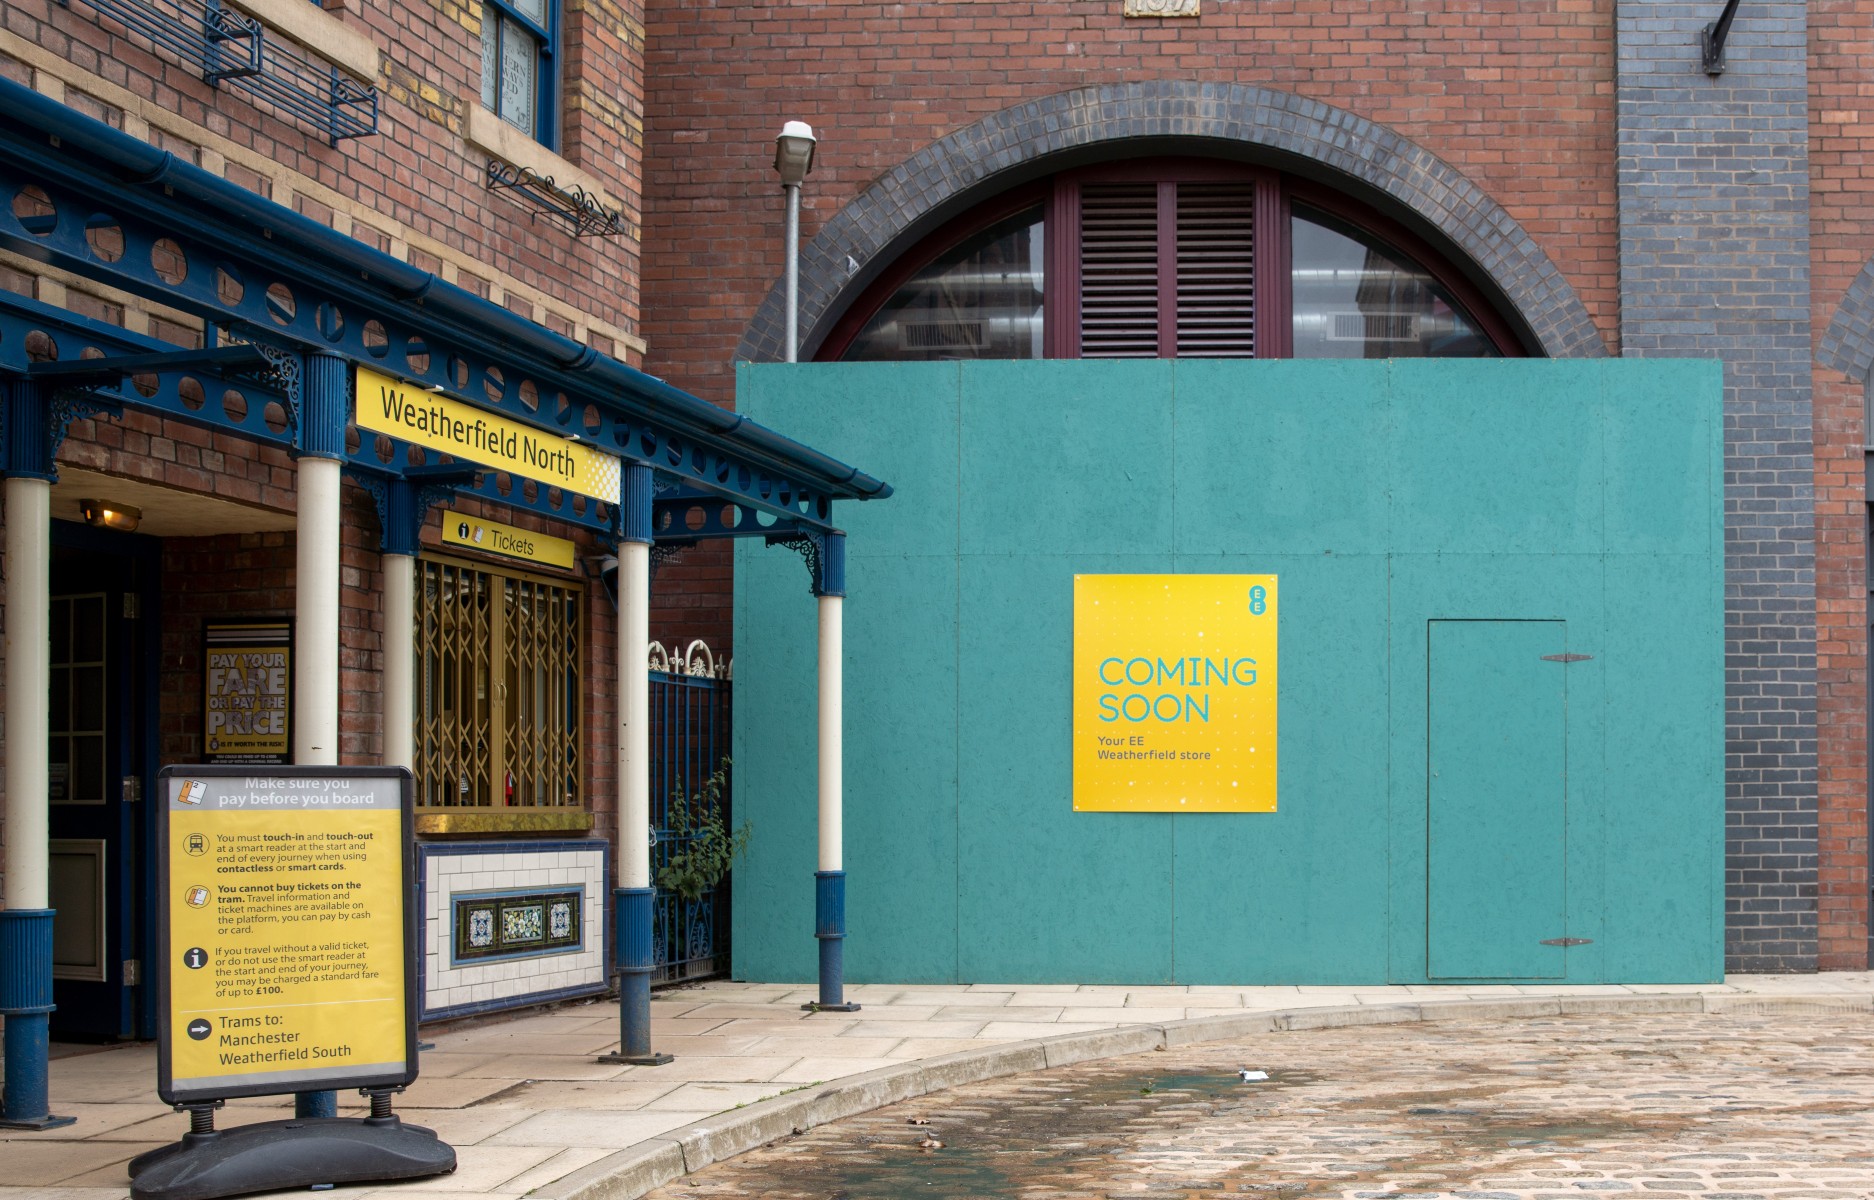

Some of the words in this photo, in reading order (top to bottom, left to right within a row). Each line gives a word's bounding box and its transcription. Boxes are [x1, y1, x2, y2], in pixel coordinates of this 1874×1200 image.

[381, 386, 518, 460] Weatherfield
[523, 436, 575, 478] North
[492, 530, 534, 555] Tickets
[211, 654, 239, 668] PAY
[243, 654, 285, 667] YOUR
[1099, 657, 1257, 686] COMING
[209, 668, 285, 695] FARE
[209, 697, 228, 709] OR
[232, 697, 257, 709] PAY
[259, 697, 285, 709] THE
[1099, 693, 1209, 723] SOON
[208, 711, 284, 735] PRICE
[1097, 737, 1125, 746] Your
[1129, 737, 1144, 746] EE
[1097, 750, 1176, 760] Weatherfield
[1180, 751, 1211, 760] store
[244, 779, 285, 791] Make
[288, 780, 320, 790] sure
[322, 781, 350, 791] you
[219, 796, 246, 807] pay
[251, 792, 298, 804] before
[302, 796, 328, 807] you
[333, 792, 374, 804] board
[217, 834, 234, 842] You
[263, 833, 304, 841] touch-in
[326, 832, 373, 840] touch-out
[266, 843, 295, 851] reader
[349, 842, 365, 850] and
[217, 855, 235, 863] end
[238, 854, 248, 862] of
[277, 854, 313, 863] journey
[343, 853, 366, 861] using
[217, 864, 273, 873] contactless
[319, 862, 346, 870] cards.
[218, 885, 236, 893] You
[277, 883, 295, 893] buy
[346, 881, 361, 889] the
[247, 894, 274, 902] Travel
[277, 891, 327, 901] information
[333, 891, 350, 899] and
[218, 905, 244, 914] ticket
[247, 904, 291, 912] machines
[311, 902, 350, 910] available
[218, 916, 234, 924] the
[237, 914, 279, 925] platform,
[282, 915, 299, 923] you
[320, 914, 336, 922] pay
[339, 912, 349, 921] by
[351, 911, 370, 919] cash
[231, 925, 253, 934] card.
[216, 947, 222, 955] If
[224, 949, 241, 957] you
[244, 945, 270, 954] travel
[273, 944, 309, 953] without
[319, 942, 340, 950] valid
[343, 941, 369, 949] ticket,
[228, 957, 239, 965] do
[281, 955, 296, 963] the
[298, 954, 324, 962] smart
[327, 952, 355, 960] reader
[216, 968, 231, 976] the
[258, 965, 275, 974] and
[278, 965, 296, 973] end
[299, 964, 308, 972] of
[310, 965, 330, 973] your
[332, 963, 369, 971] journey,
[216, 980, 233, 988] you
[237, 979, 256, 987] may
[273, 974, 310, 984] charged
[321, 971, 359, 981] standard
[216, 989, 226, 997] of
[228, 990, 241, 998] up
[256, 986, 283, 995] £100.
[219, 1016, 261, 1028] Trams
[265, 1015, 282, 1025] to:
[220, 1032, 300, 1047] Manchester
[219, 1048, 308, 1065] Weatherfield
[313, 1045, 351, 1058] South
